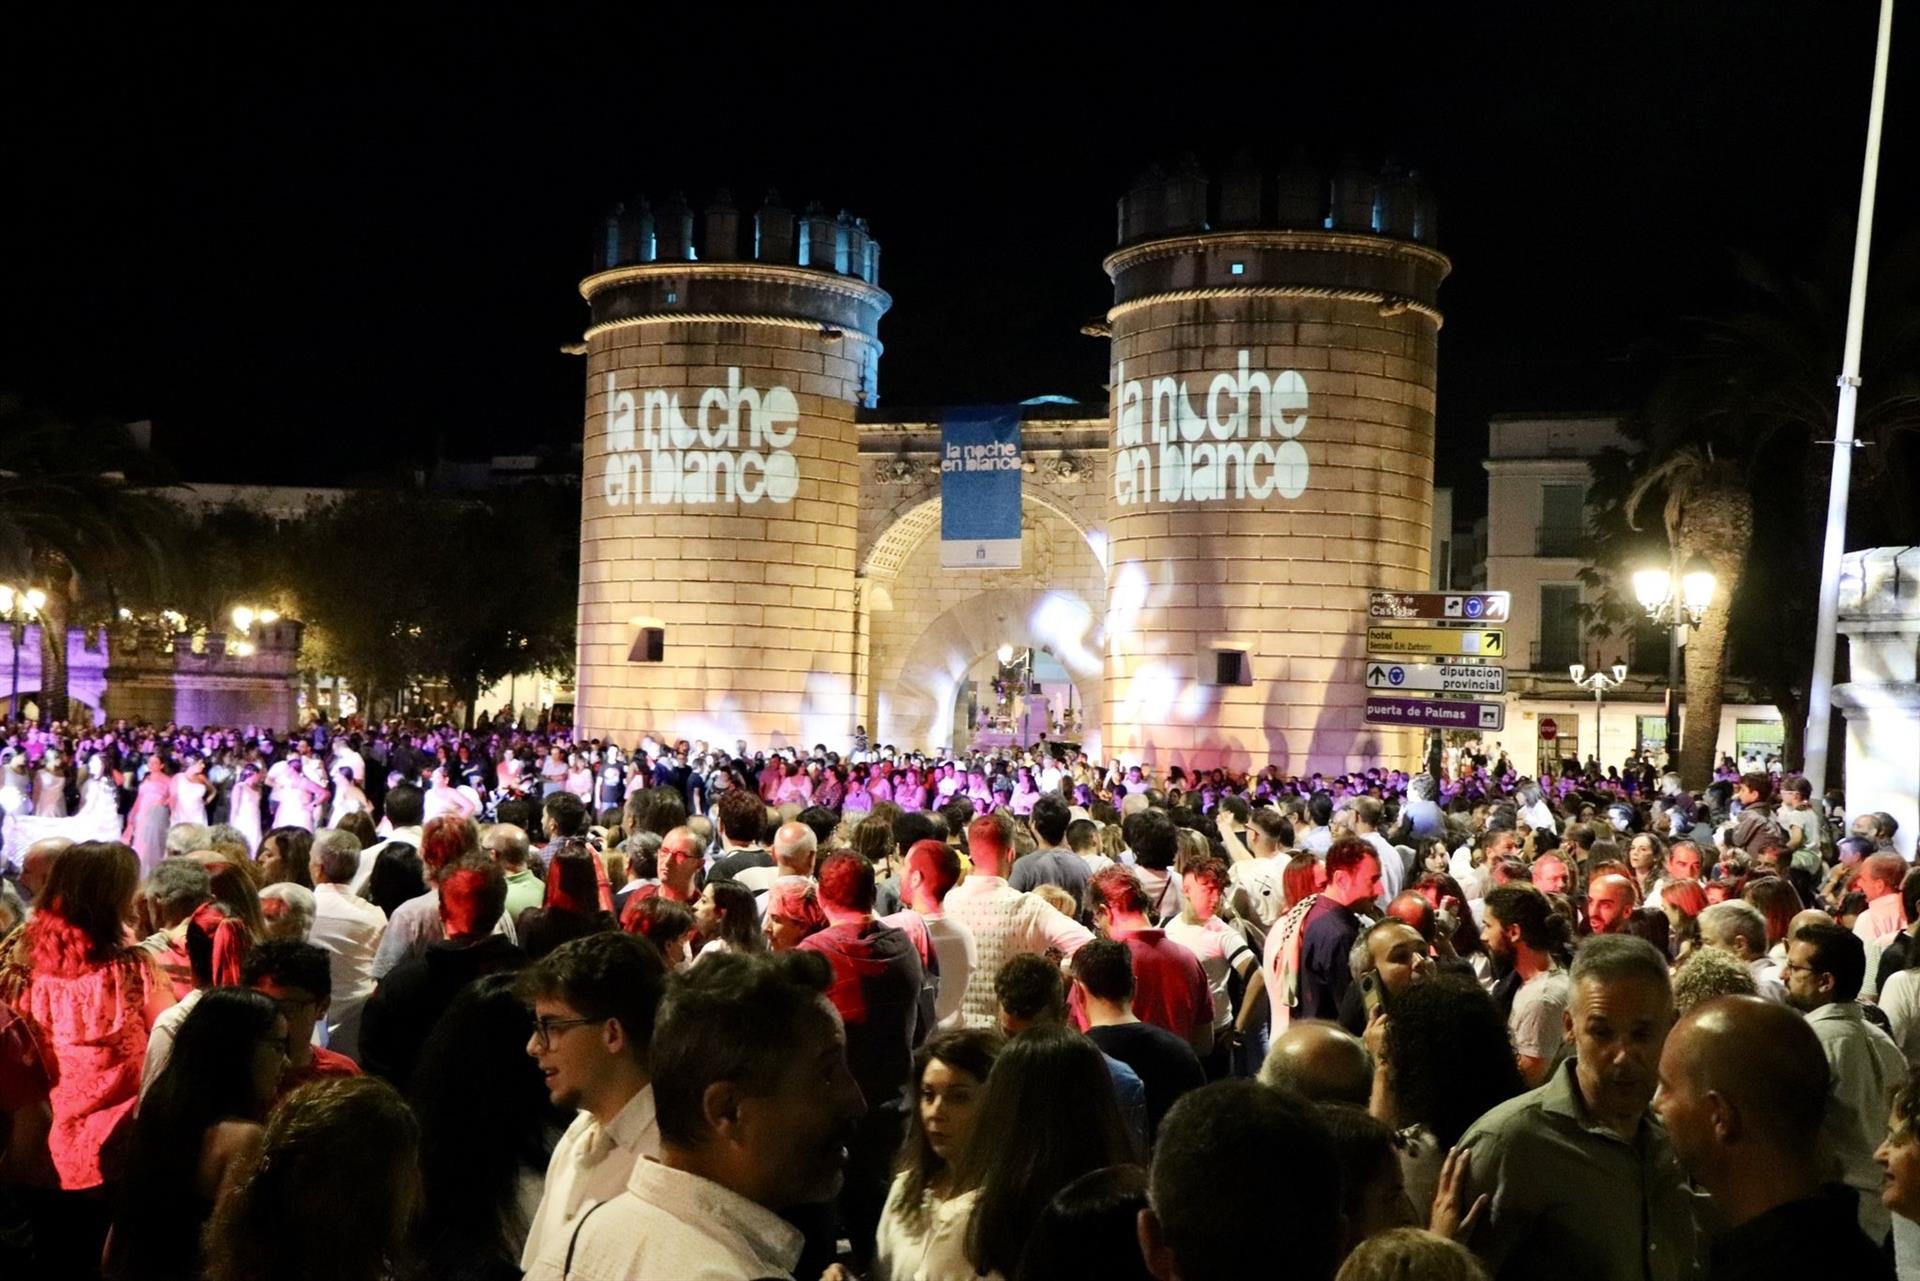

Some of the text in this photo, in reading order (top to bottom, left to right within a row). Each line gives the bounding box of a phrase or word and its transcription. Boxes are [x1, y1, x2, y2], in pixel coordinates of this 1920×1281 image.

[607, 373, 635, 451] la
[1117, 361, 1143, 446] la
[946, 440, 1016, 458] la noche
[604, 434, 800, 507] en blanco
[941, 452, 1022, 472] en blanco
[1115, 426, 1310, 506] en blanco
[1370, 631, 1393, 640] hotel
[1443, 679, 1500, 691] provincial
[1367, 704, 1466, 719] puerta de Palmas
